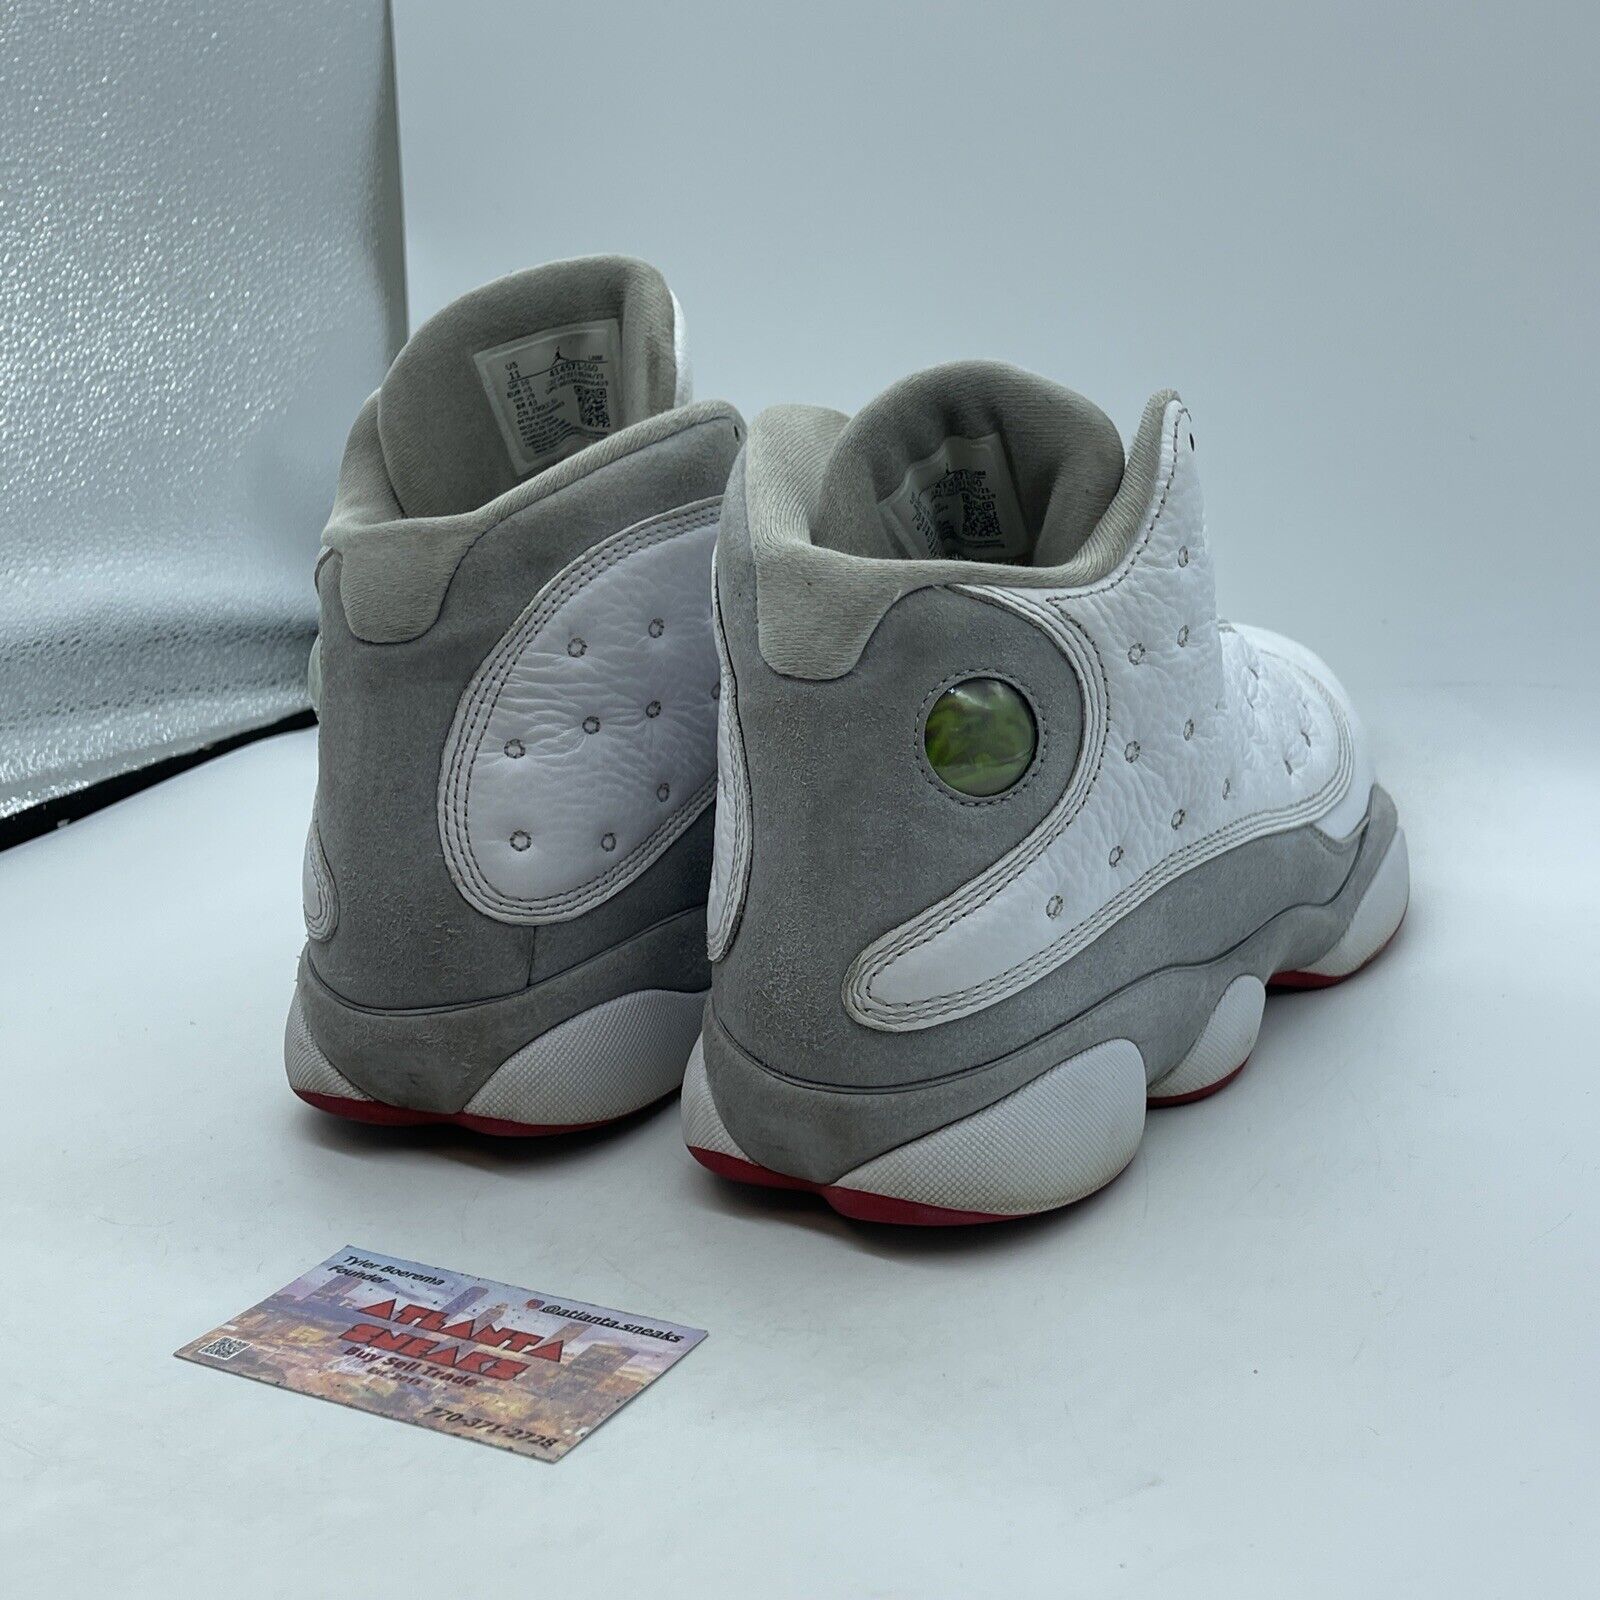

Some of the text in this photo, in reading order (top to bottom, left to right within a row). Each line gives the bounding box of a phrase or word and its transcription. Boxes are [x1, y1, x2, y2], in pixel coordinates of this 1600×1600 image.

[327, 1265, 390, 1284] Founder
[343, 1255, 445, 1286] Tyler Boerema
[356, 1298, 564, 1363] ATLANTA
[539, 1304, 685, 1343] @atlanta.sneaks
[338, 1322, 532, 1381] SNEAKS
[344, 1346, 478, 1387] Buy Sell Trade
